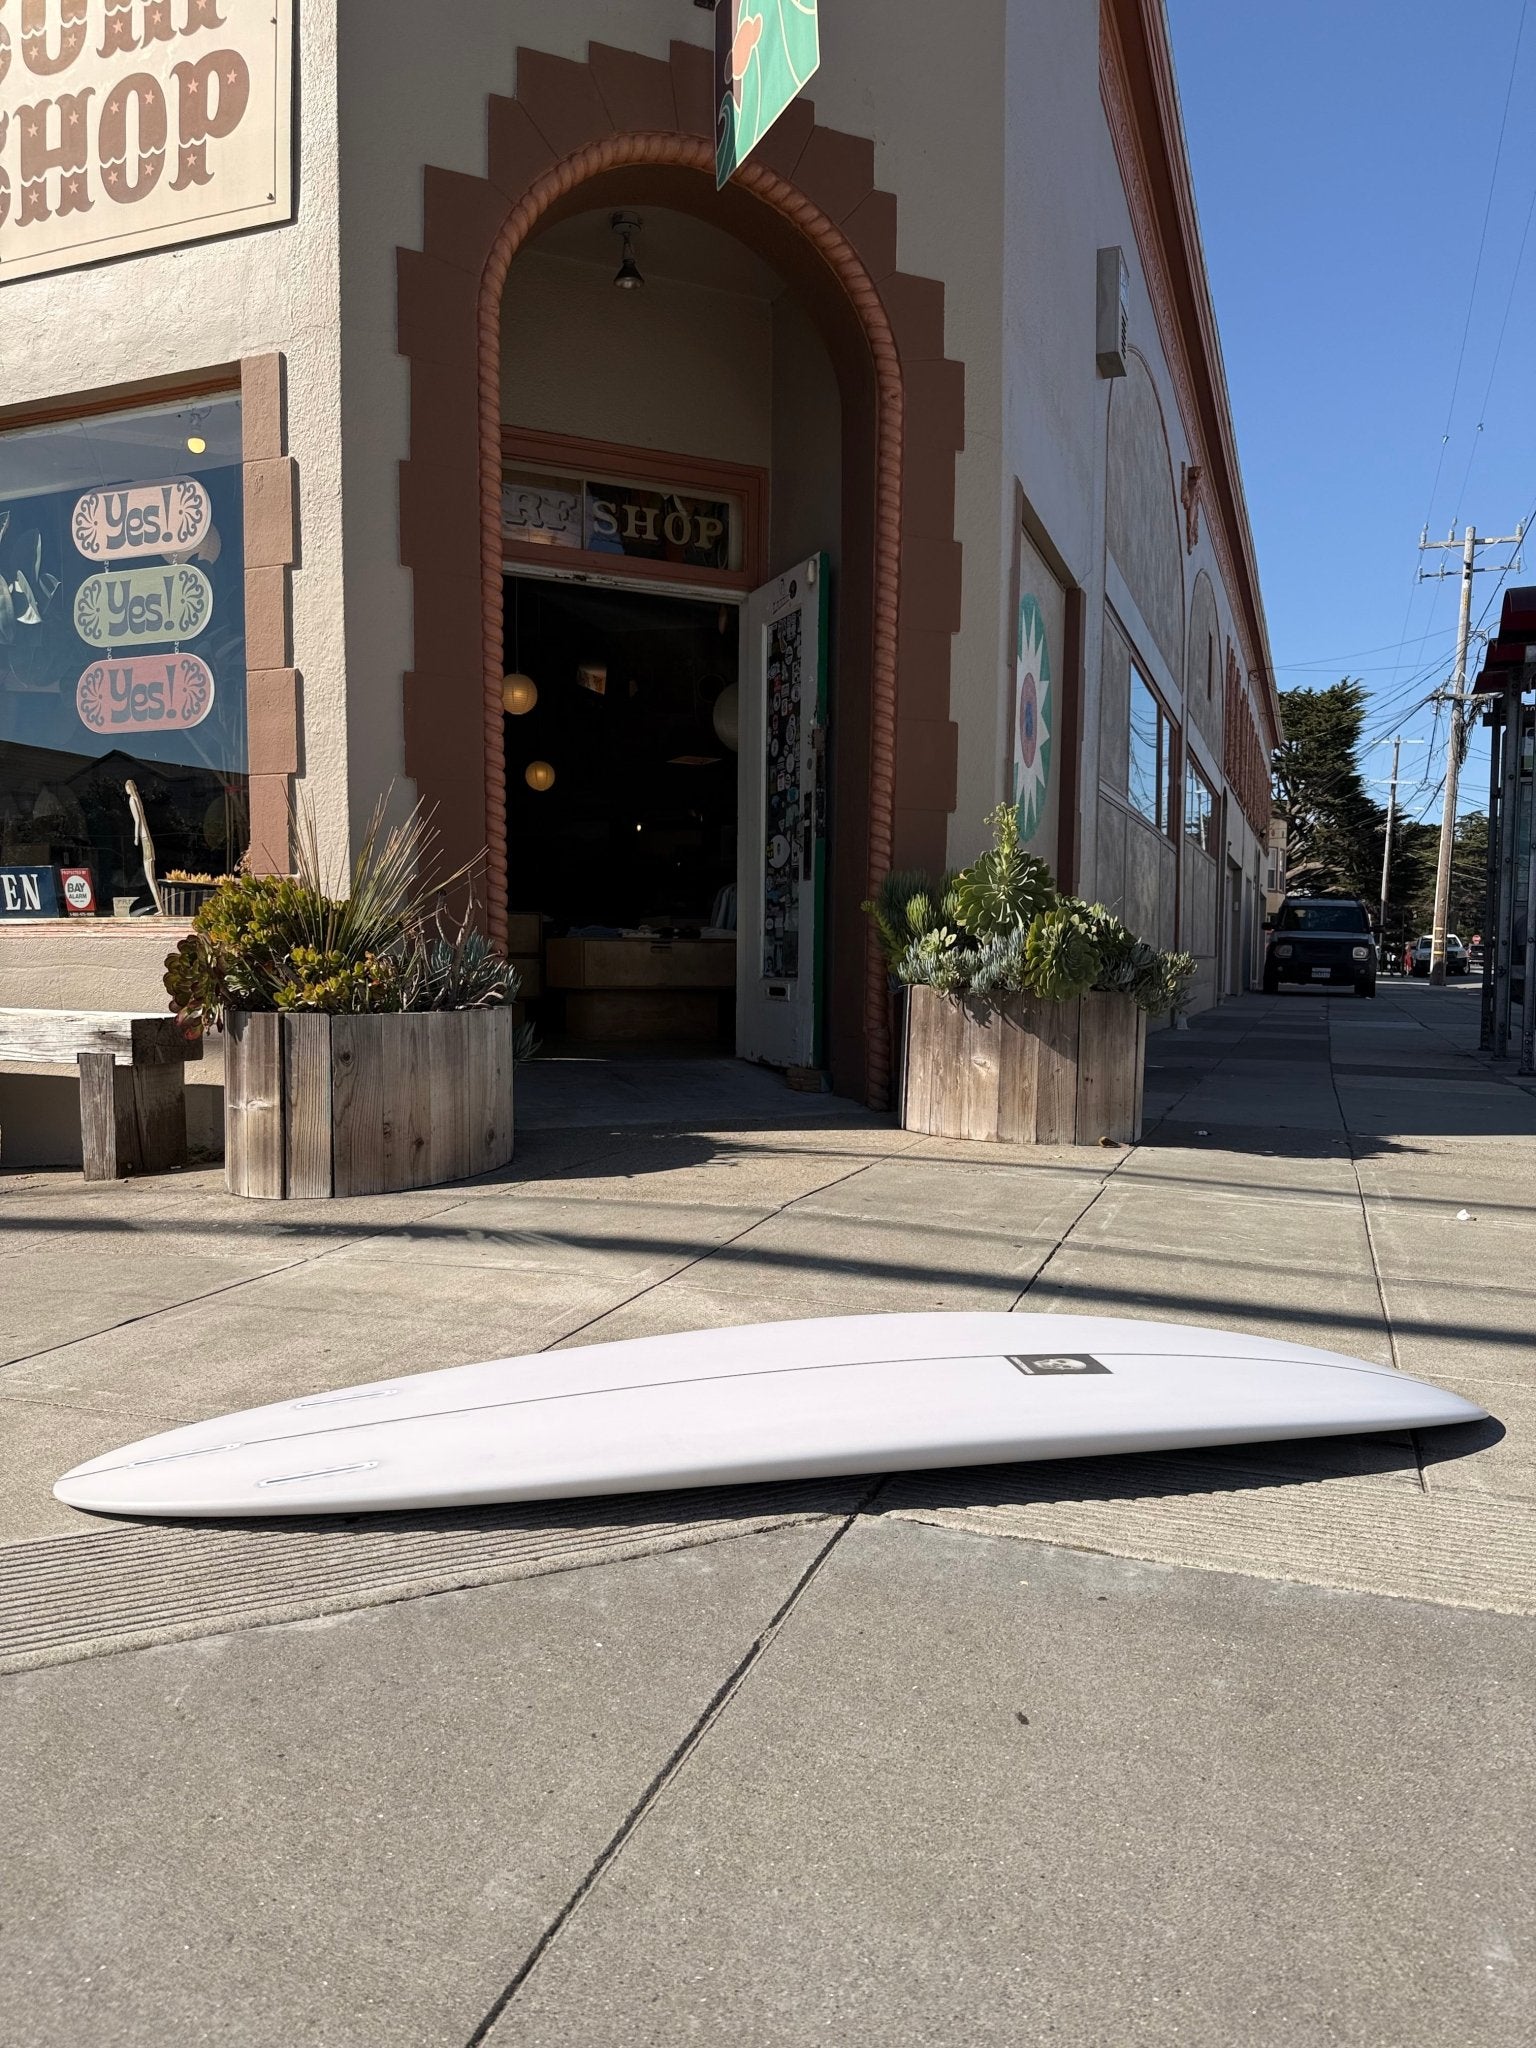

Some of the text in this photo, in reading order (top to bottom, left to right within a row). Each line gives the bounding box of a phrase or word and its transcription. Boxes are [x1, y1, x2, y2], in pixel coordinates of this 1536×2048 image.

[0, 49, 250, 228] HOP
[103, 487, 173, 549] Yes!
[502, 486, 724, 550] RF SHOP
[105, 575, 175, 637] Yes!
[108, 664, 177, 724] Yes!
[67, 882, 86, 893] BAY
